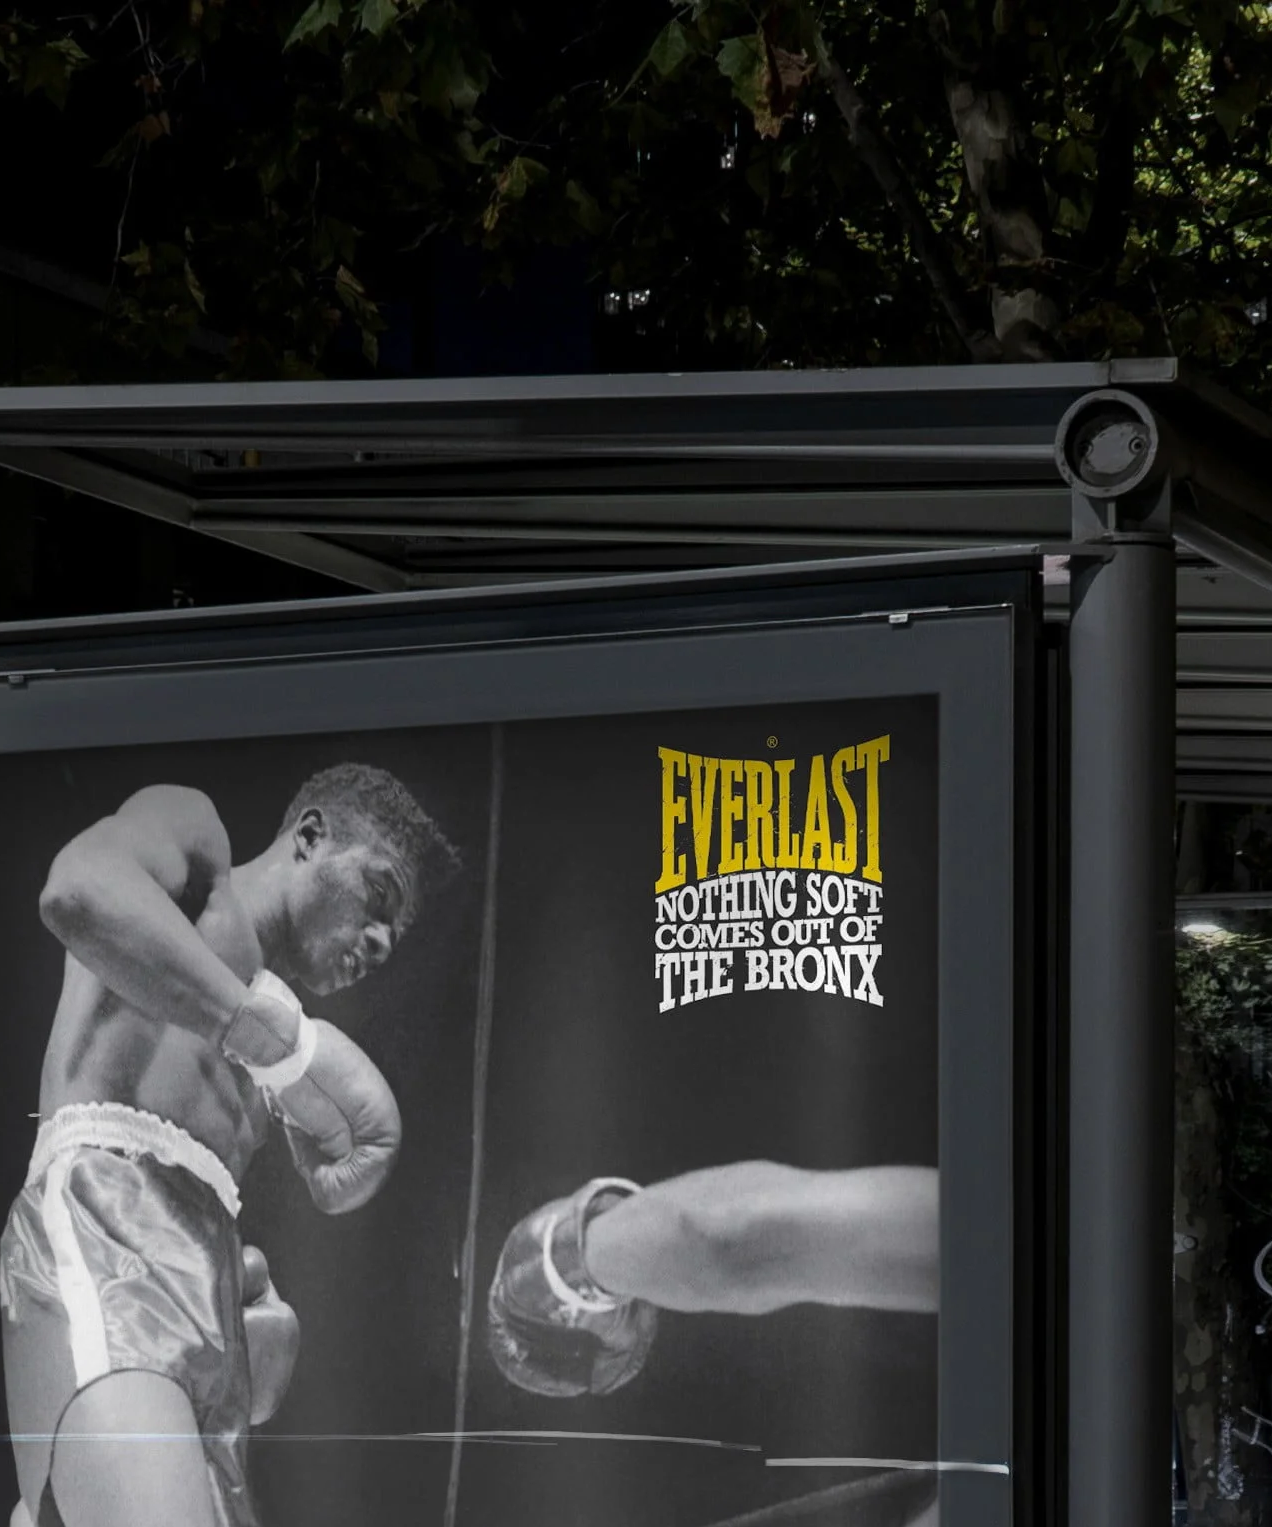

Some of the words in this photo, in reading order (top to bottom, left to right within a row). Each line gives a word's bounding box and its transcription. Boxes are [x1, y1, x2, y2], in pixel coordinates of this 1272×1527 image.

[655, 734, 890, 894] EVERLAST
[655, 870, 797, 923] NOTHING
[806, 872, 883, 917] SOFT
[655, 921, 765, 950] COMES
[771, 918, 834, 946] OUT
[840, 915, 883, 943] OF
[655, 951, 733, 1013] THE
[744, 944, 884, 1007] BRONX
